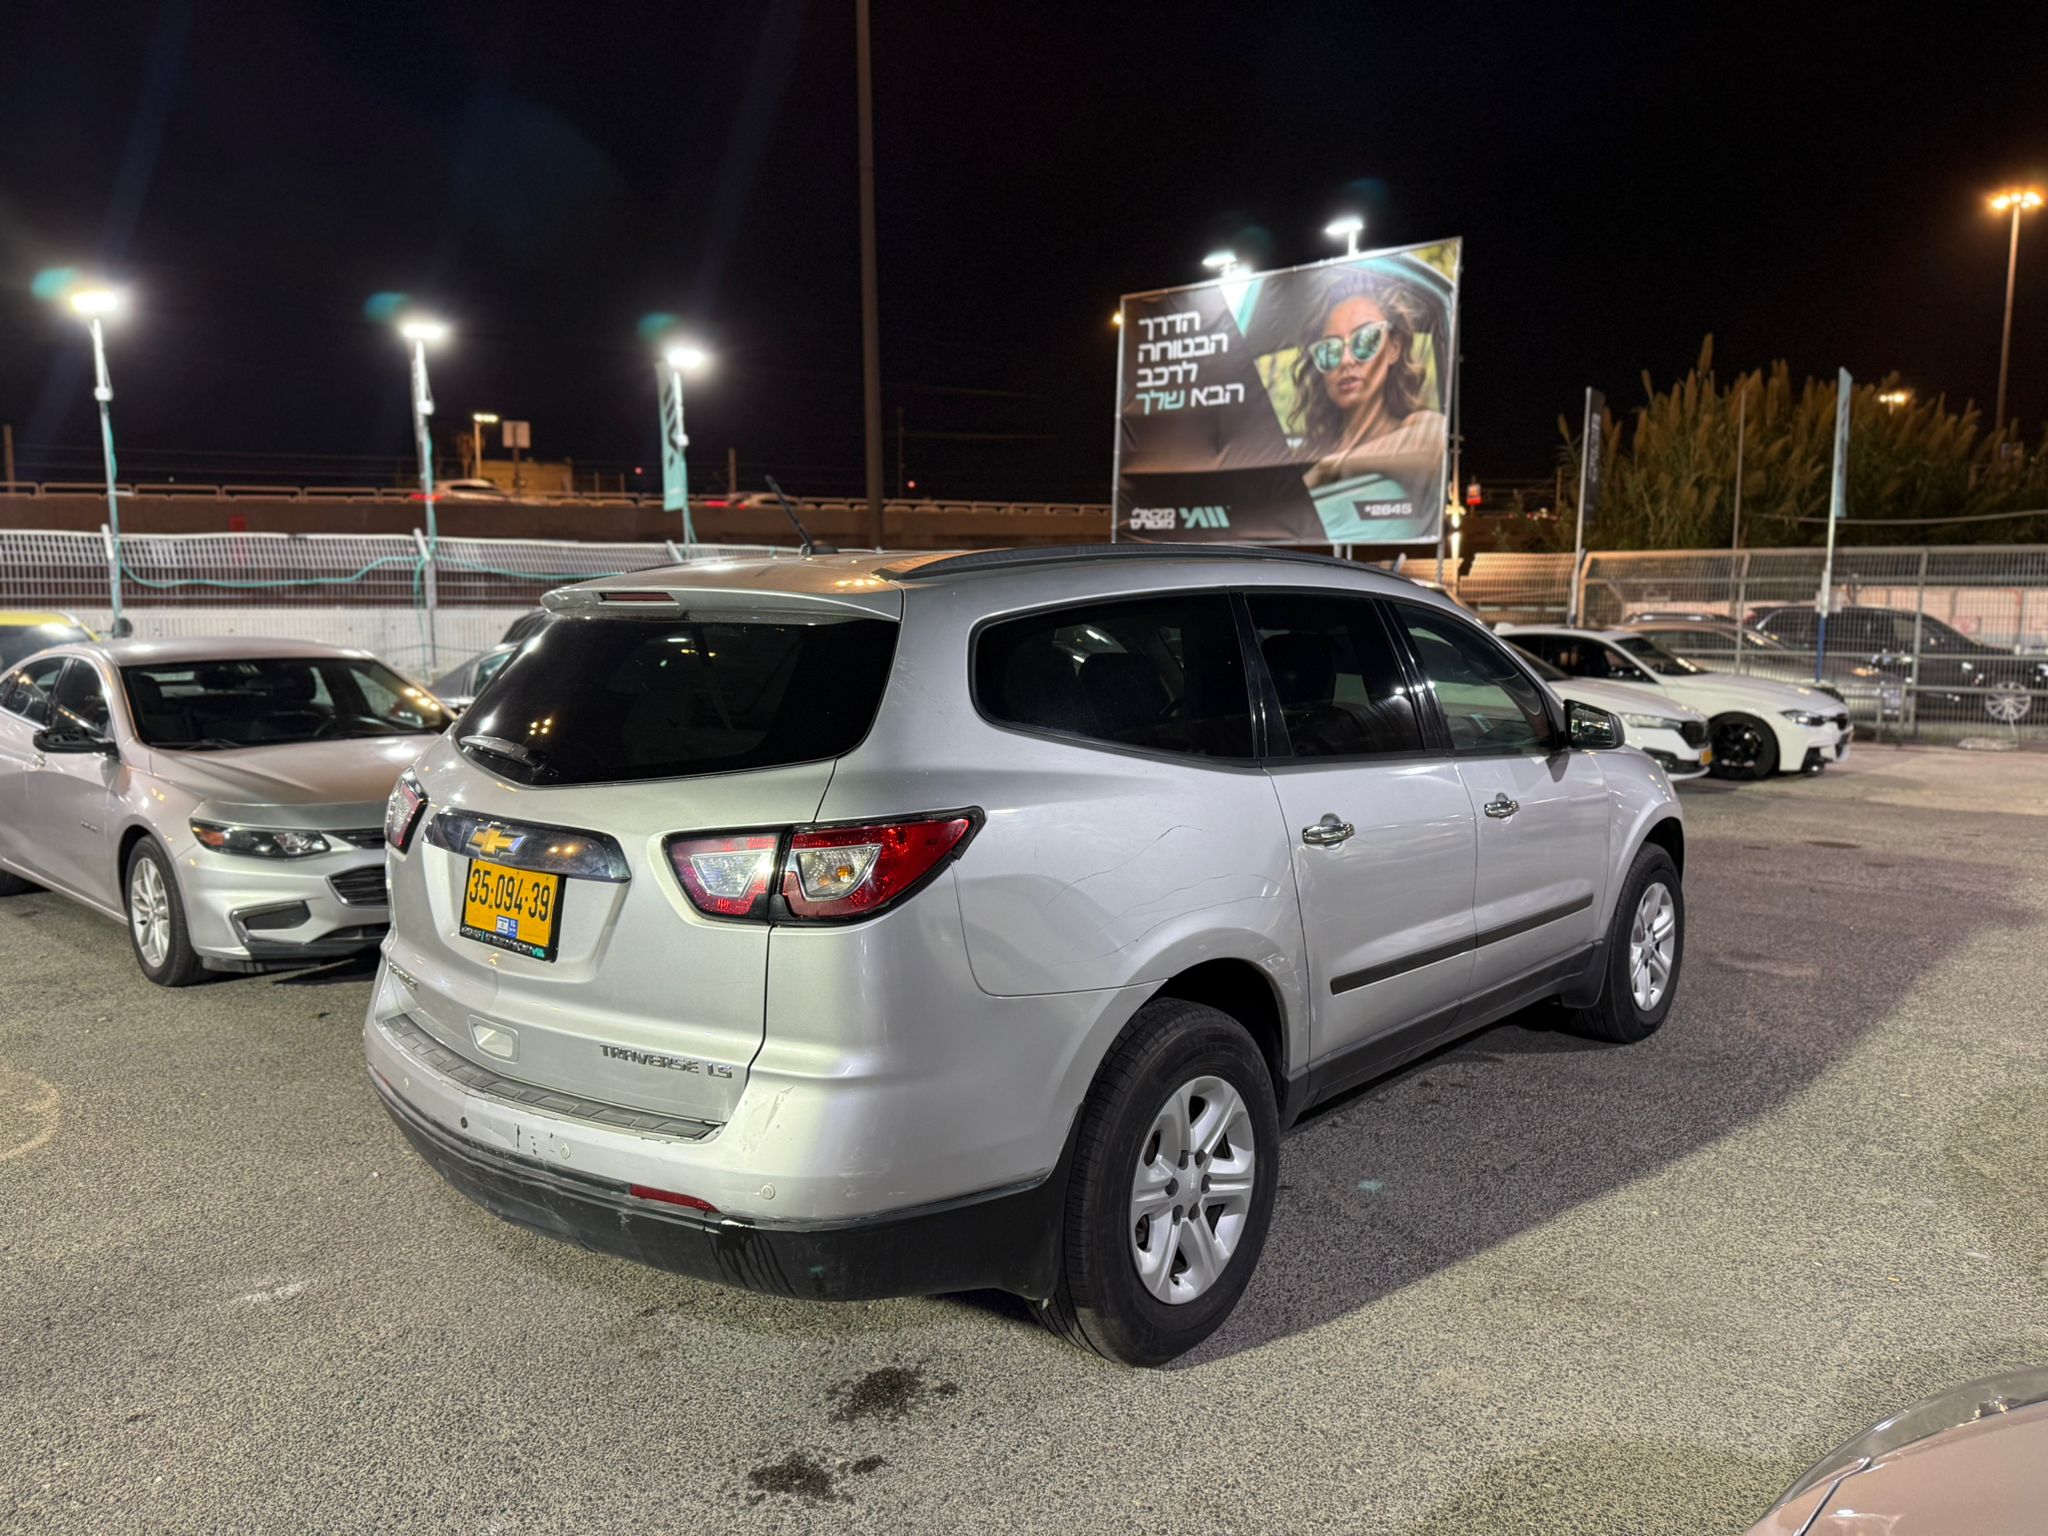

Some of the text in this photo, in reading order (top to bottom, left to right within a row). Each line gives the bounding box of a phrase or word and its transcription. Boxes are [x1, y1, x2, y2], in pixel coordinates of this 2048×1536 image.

[1138, 311, 1200, 341] הדרך
[1138, 333, 1228, 363] הבטוחה
[1136, 361, 1198, 388] לרכב
[1136, 383, 1245, 416] הבא שלך
[599, 1044, 733, 1079] TRAVERSE LS
